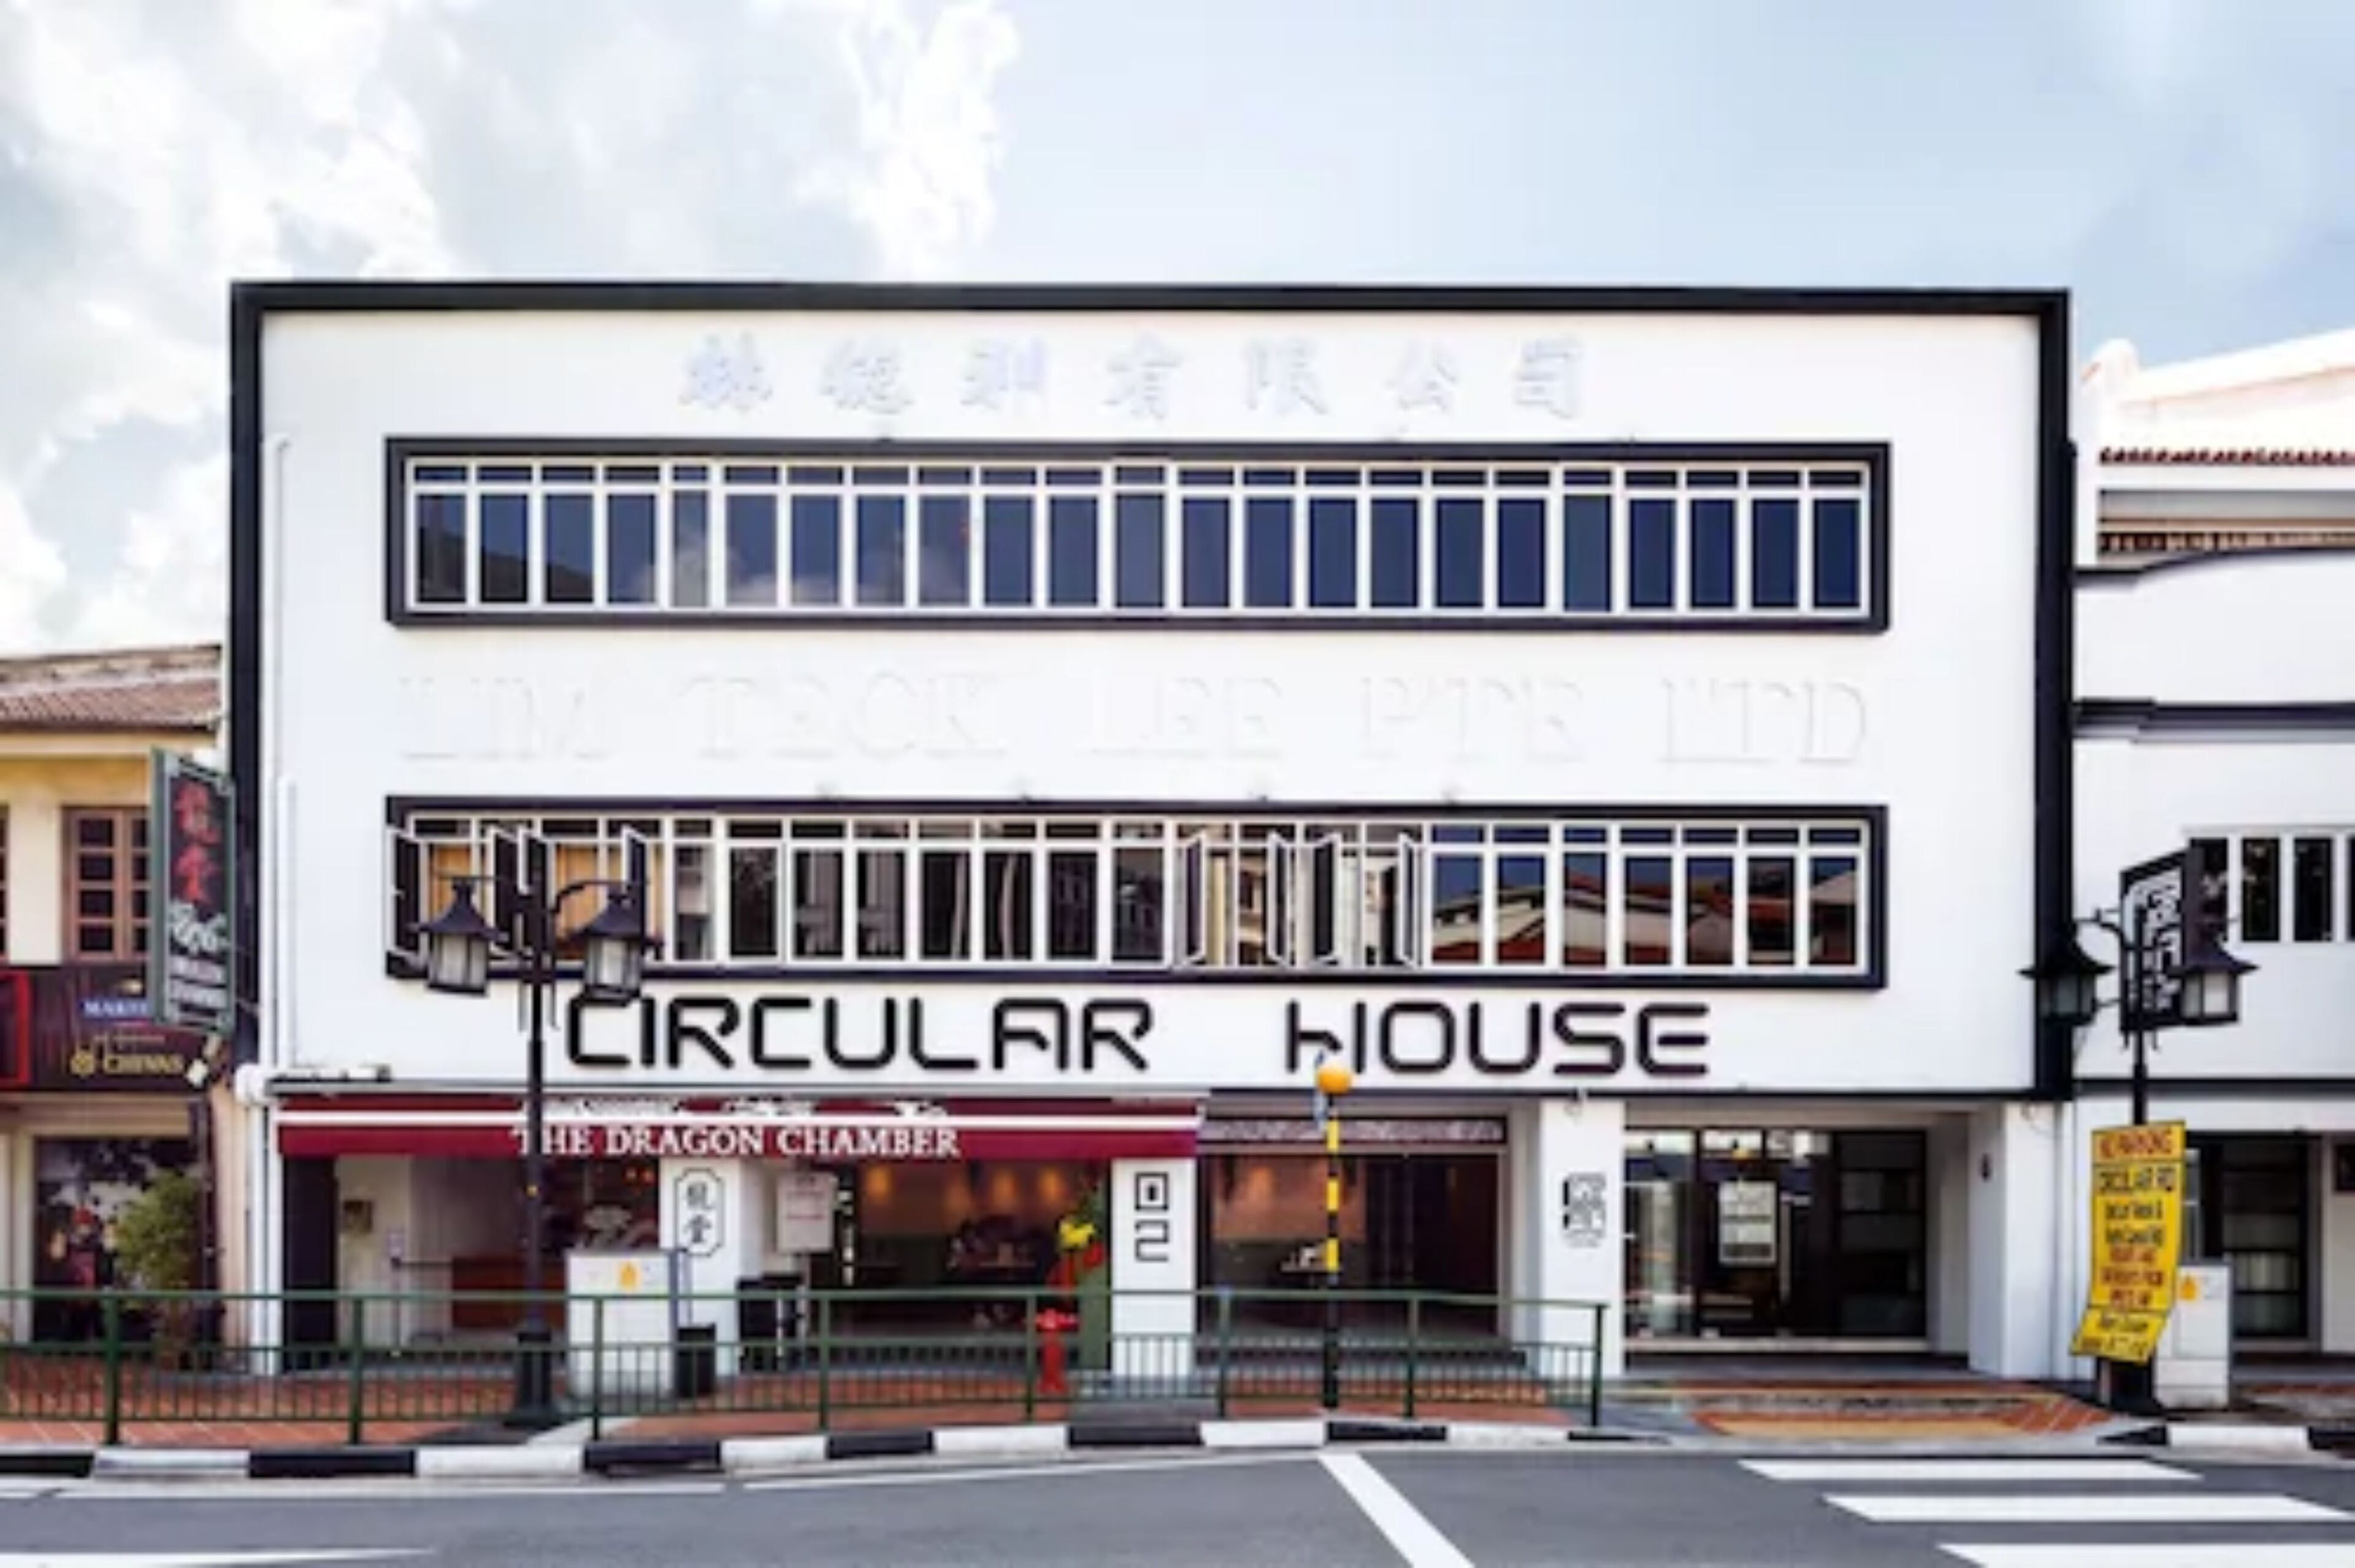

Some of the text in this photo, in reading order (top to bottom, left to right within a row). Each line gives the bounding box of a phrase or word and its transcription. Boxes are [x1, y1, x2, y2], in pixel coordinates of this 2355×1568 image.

[398, 673, 1868, 767] LIM TECK LEE PTE LTD
[565, 996, 1710, 1076] CIRCULAR HOUSE
[510, 1125, 960, 1158] THE DRAGON CHAMBER
